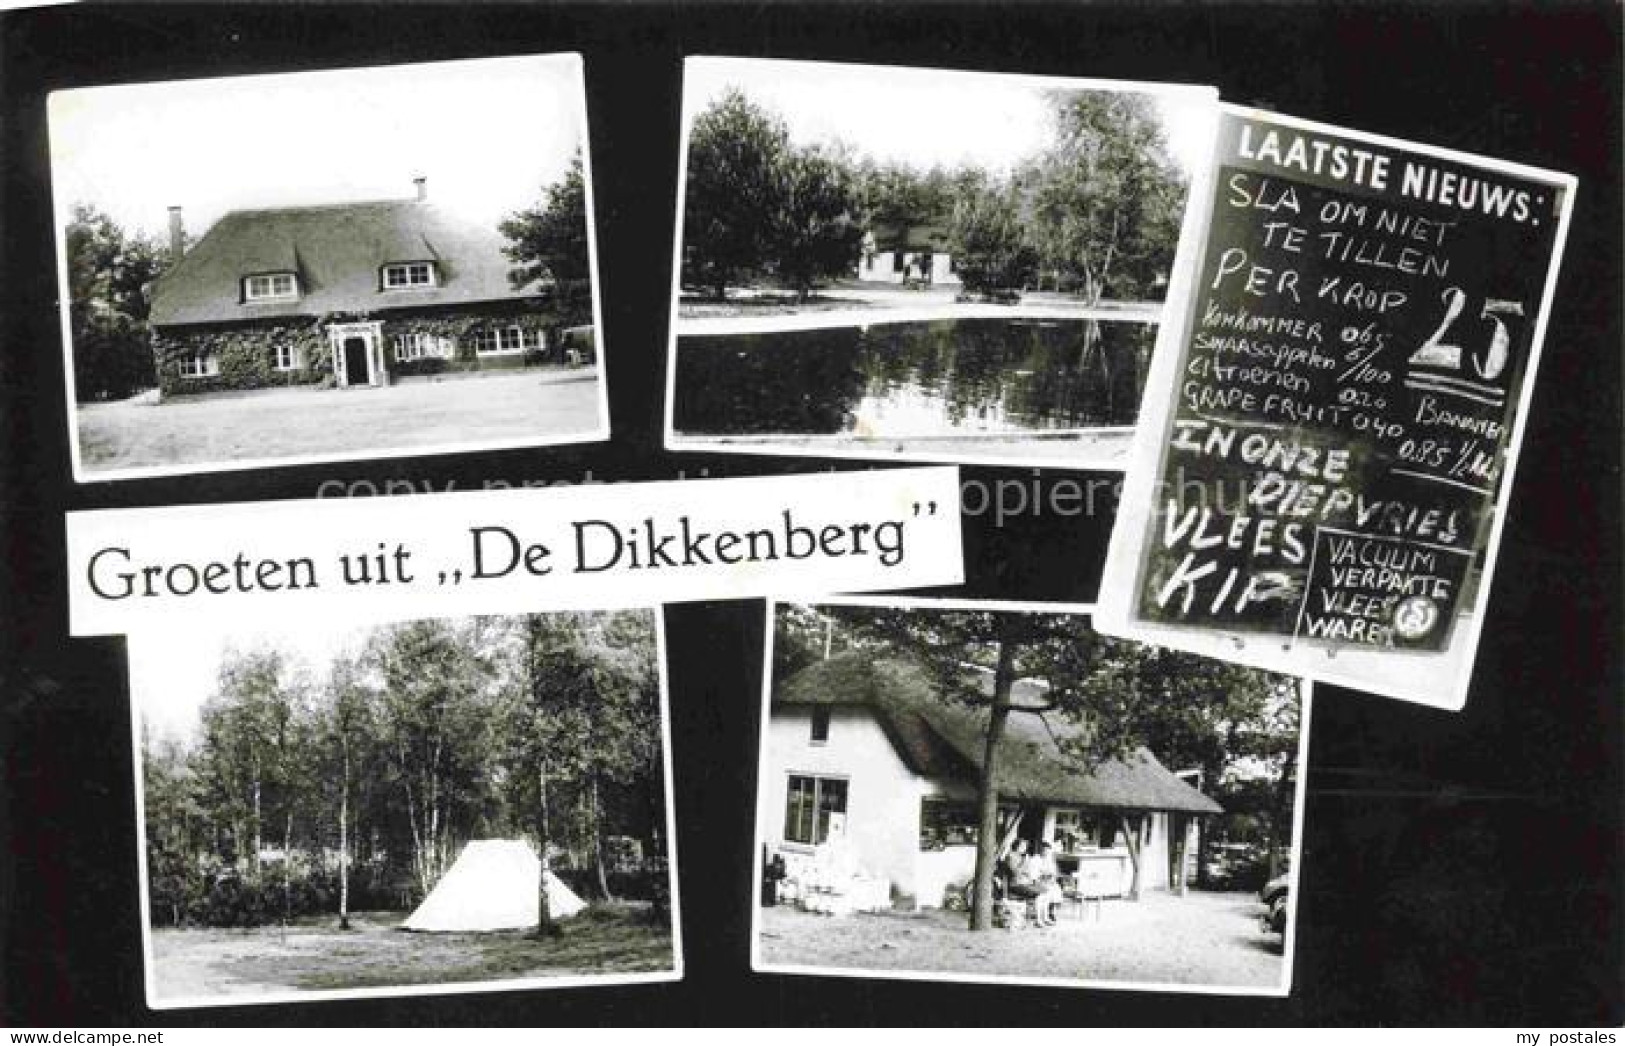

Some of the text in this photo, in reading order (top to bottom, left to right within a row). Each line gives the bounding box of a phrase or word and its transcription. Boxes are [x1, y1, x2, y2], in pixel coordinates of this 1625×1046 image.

[1239, 125, 1545, 226] LAATSTE NIEUWS:
[1229, 174, 1456, 246] SLA OM NIET
[1212, 248, 1408, 313] PER KROP
[1262, 222, 1450, 277] TE TILLEN
[1407, 287, 1525, 380] 25
[1171, 420, 1351, 481] IN ONZE
[1164, 498, 1306, 563] VLEES
[1328, 538, 1436, 572] VACUUM
[87, 547, 320, 600] Groeten
[339, 542, 414, 586] uit
[1157, 552, 1294, 614] KIP
